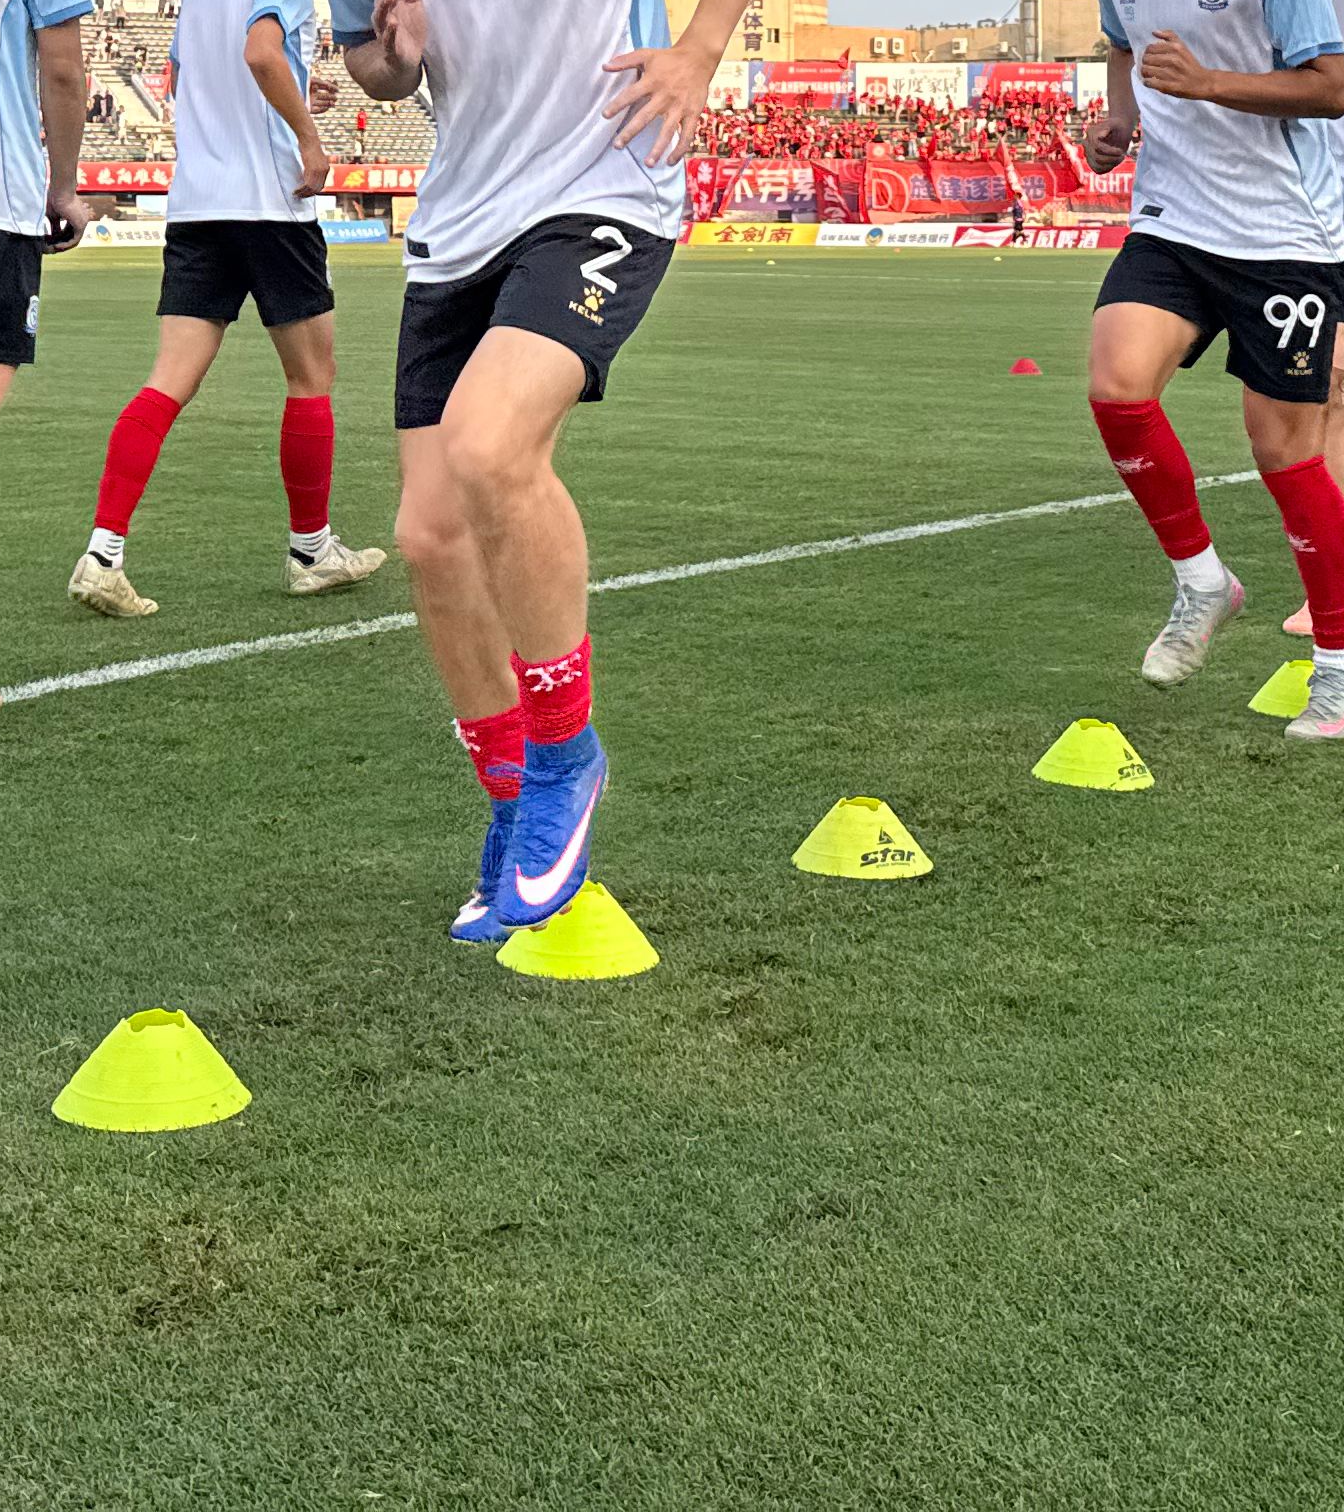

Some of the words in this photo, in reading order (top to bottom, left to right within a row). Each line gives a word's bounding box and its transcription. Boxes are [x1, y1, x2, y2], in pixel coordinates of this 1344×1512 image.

[579, 225, 633, 294] 2
[568, 299, 605, 327] KELME
[1262, 292, 1327, 350] 99
[859, 847, 916, 868] star
